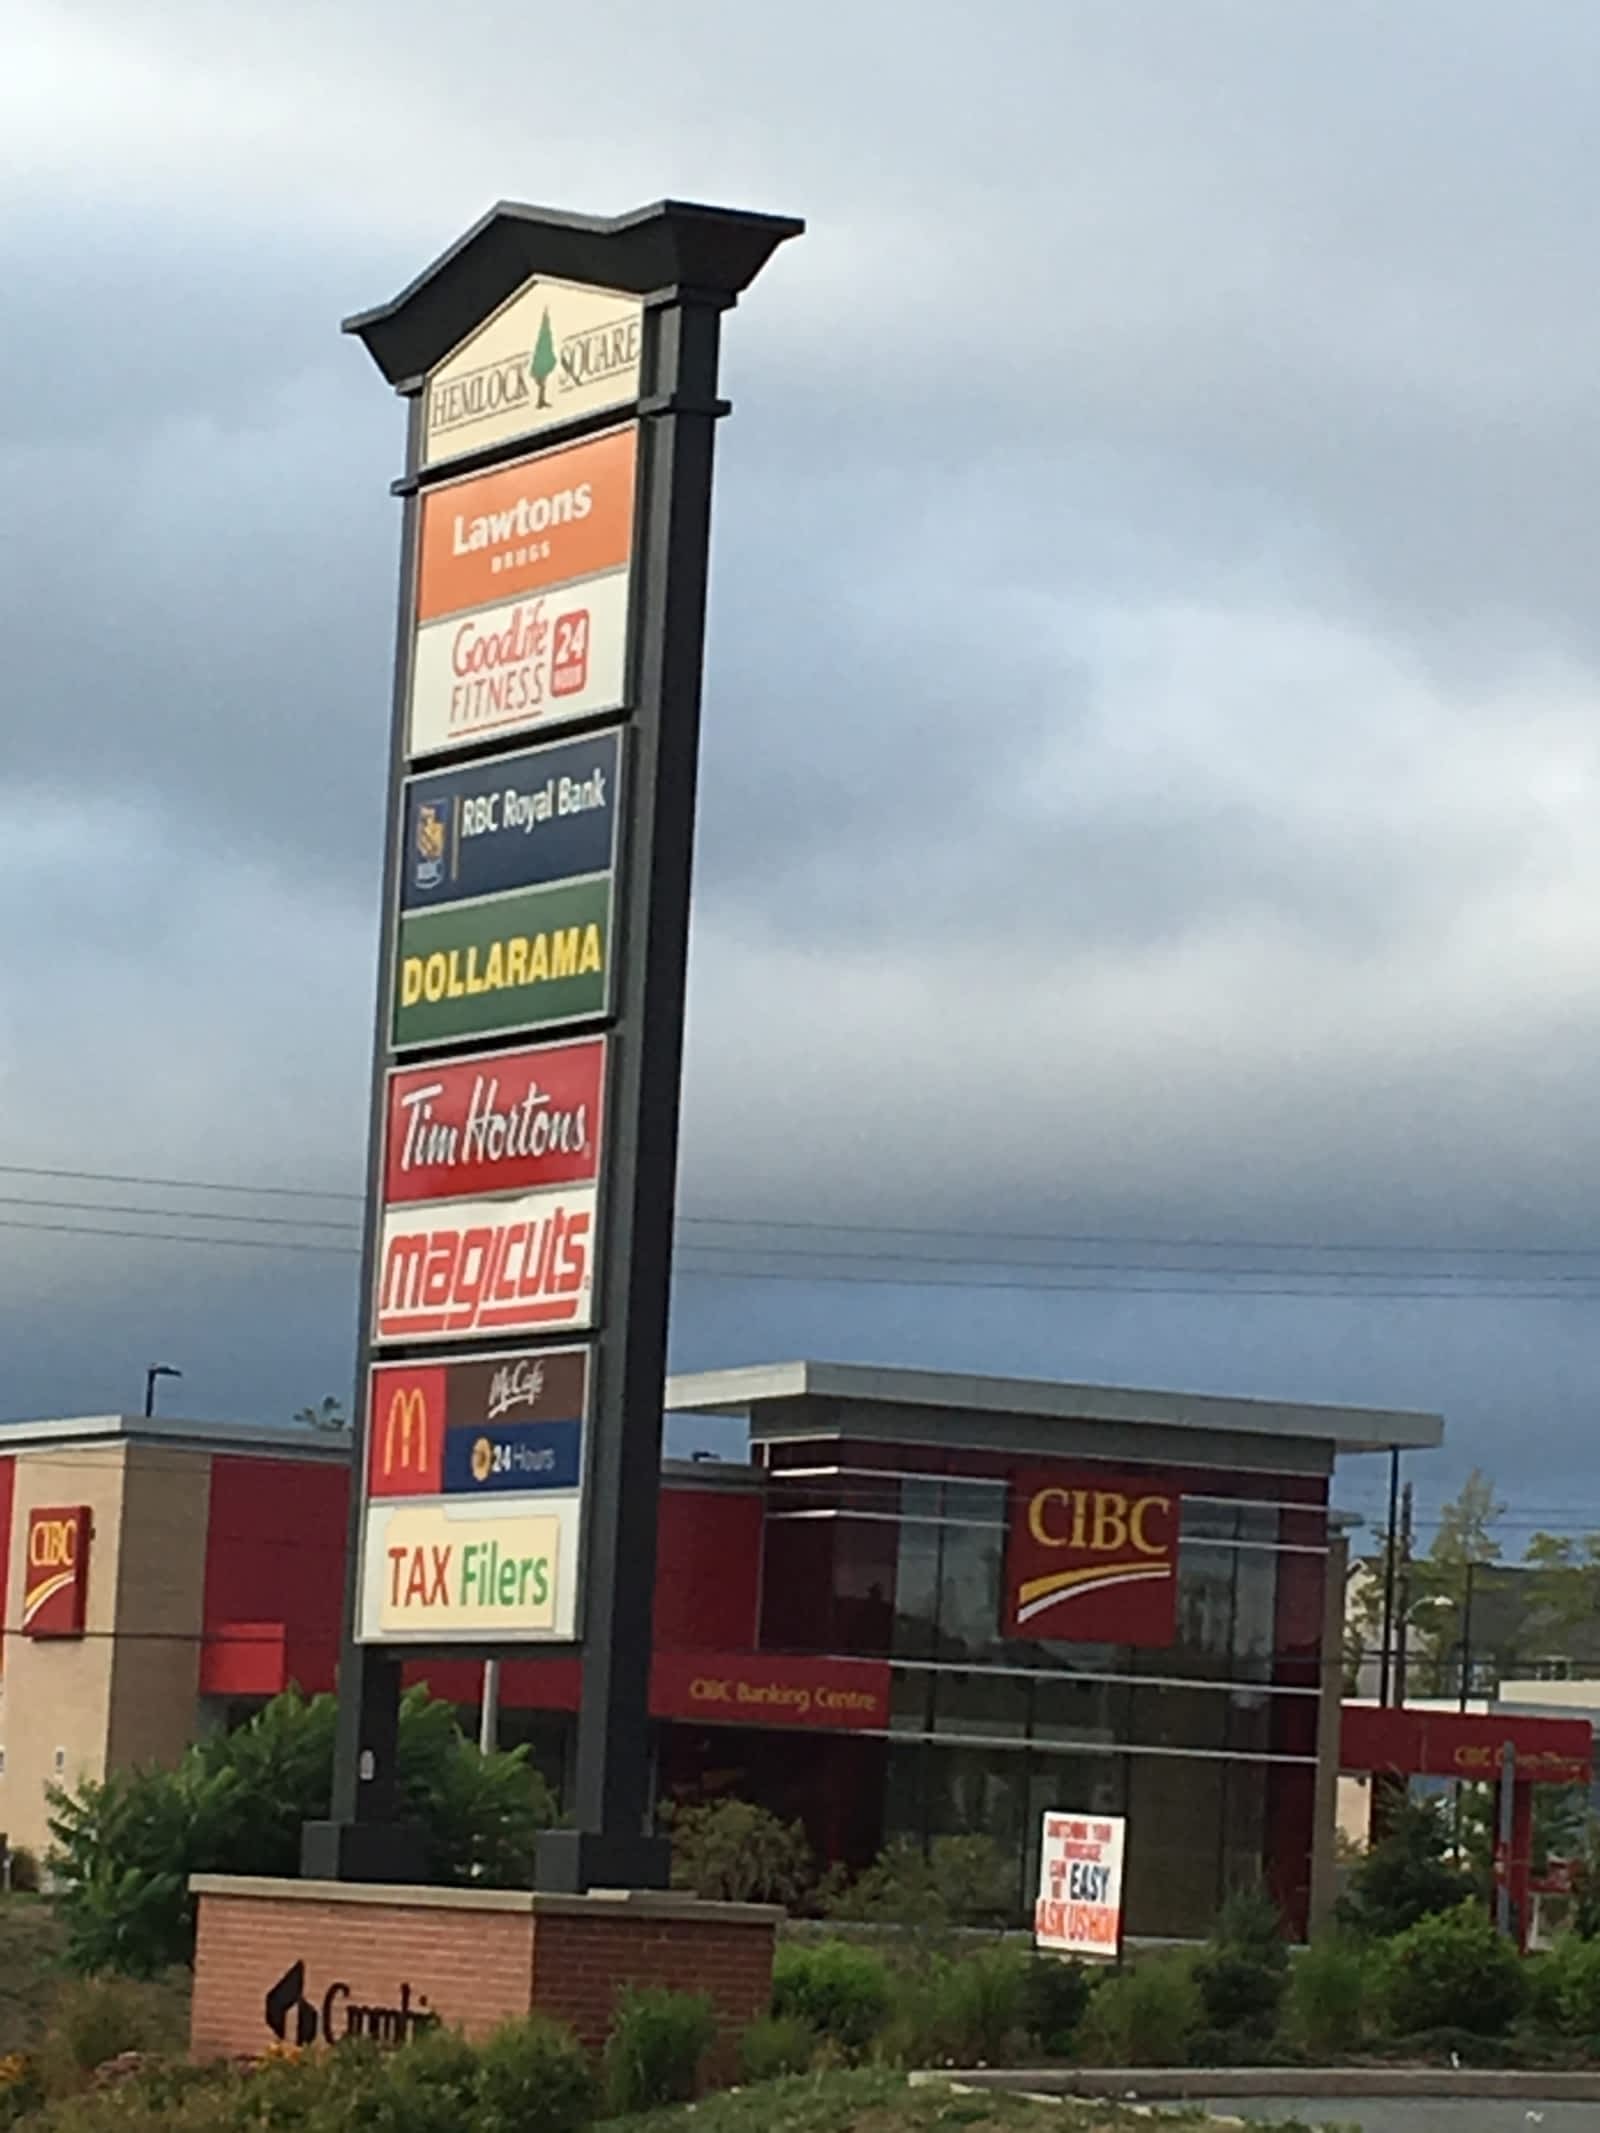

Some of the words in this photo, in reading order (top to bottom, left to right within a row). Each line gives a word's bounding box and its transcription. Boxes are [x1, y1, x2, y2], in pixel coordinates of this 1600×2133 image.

[432, 358, 529, 429] HEMLOCK
[558, 322, 639, 389] SQUARE
[452, 483, 593, 556] Lawtons
[554, 617, 586, 665] 24
[449, 662, 545, 724] FITNESS
[461, 795, 499, 838] RBC
[502, 779, 553, 834] Royal
[557, 767, 607, 816] Bank
[402, 923, 602, 1008] DOLLARAMA
[400, 1083, 459, 1172] Tim
[461, 1075, 586, 1165] Hortons
[492, 1443, 512, 1474] 24
[512, 1443, 556, 1473] Hours
[30, 1518, 78, 1567] CIBC
[1027, 1486, 1172, 1556] CIBC
[387, 1543, 453, 1608] TAX
[459, 1540, 549, 1608] Filers
[1069, 1862, 1111, 1904] EASY
